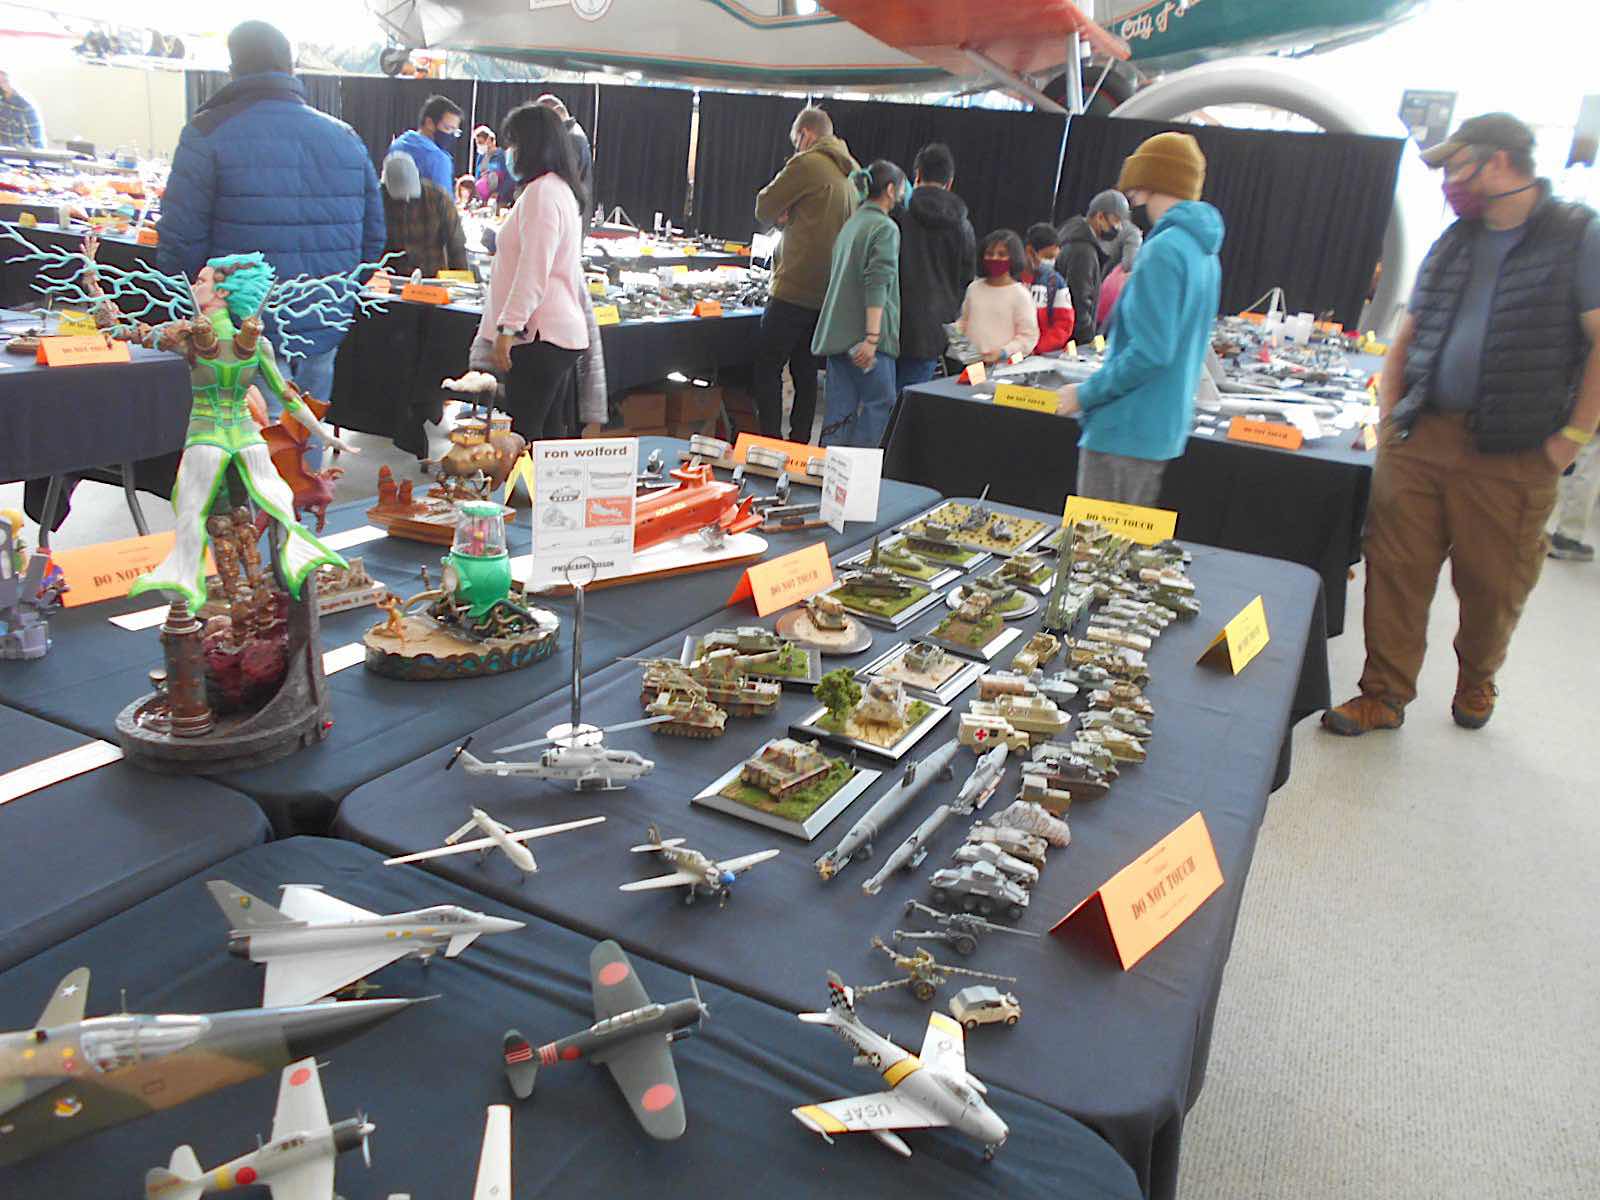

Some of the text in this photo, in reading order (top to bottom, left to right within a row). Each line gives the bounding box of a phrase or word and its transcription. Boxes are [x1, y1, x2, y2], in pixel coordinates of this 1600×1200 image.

[1121, 14, 1153, 40] City
[1156, 1, 1176, 32] of
[544, 446, 628, 459] ron wolford
[1086, 512, 1154, 531] DO NOT TOUCH
[93, 574, 112, 587] DO
[116, 567, 143, 583] NOT
[1131, 896, 1147, 921] DO
[1147, 881, 1167, 905] NOT
[1166, 855, 1196, 890] TOUCH
